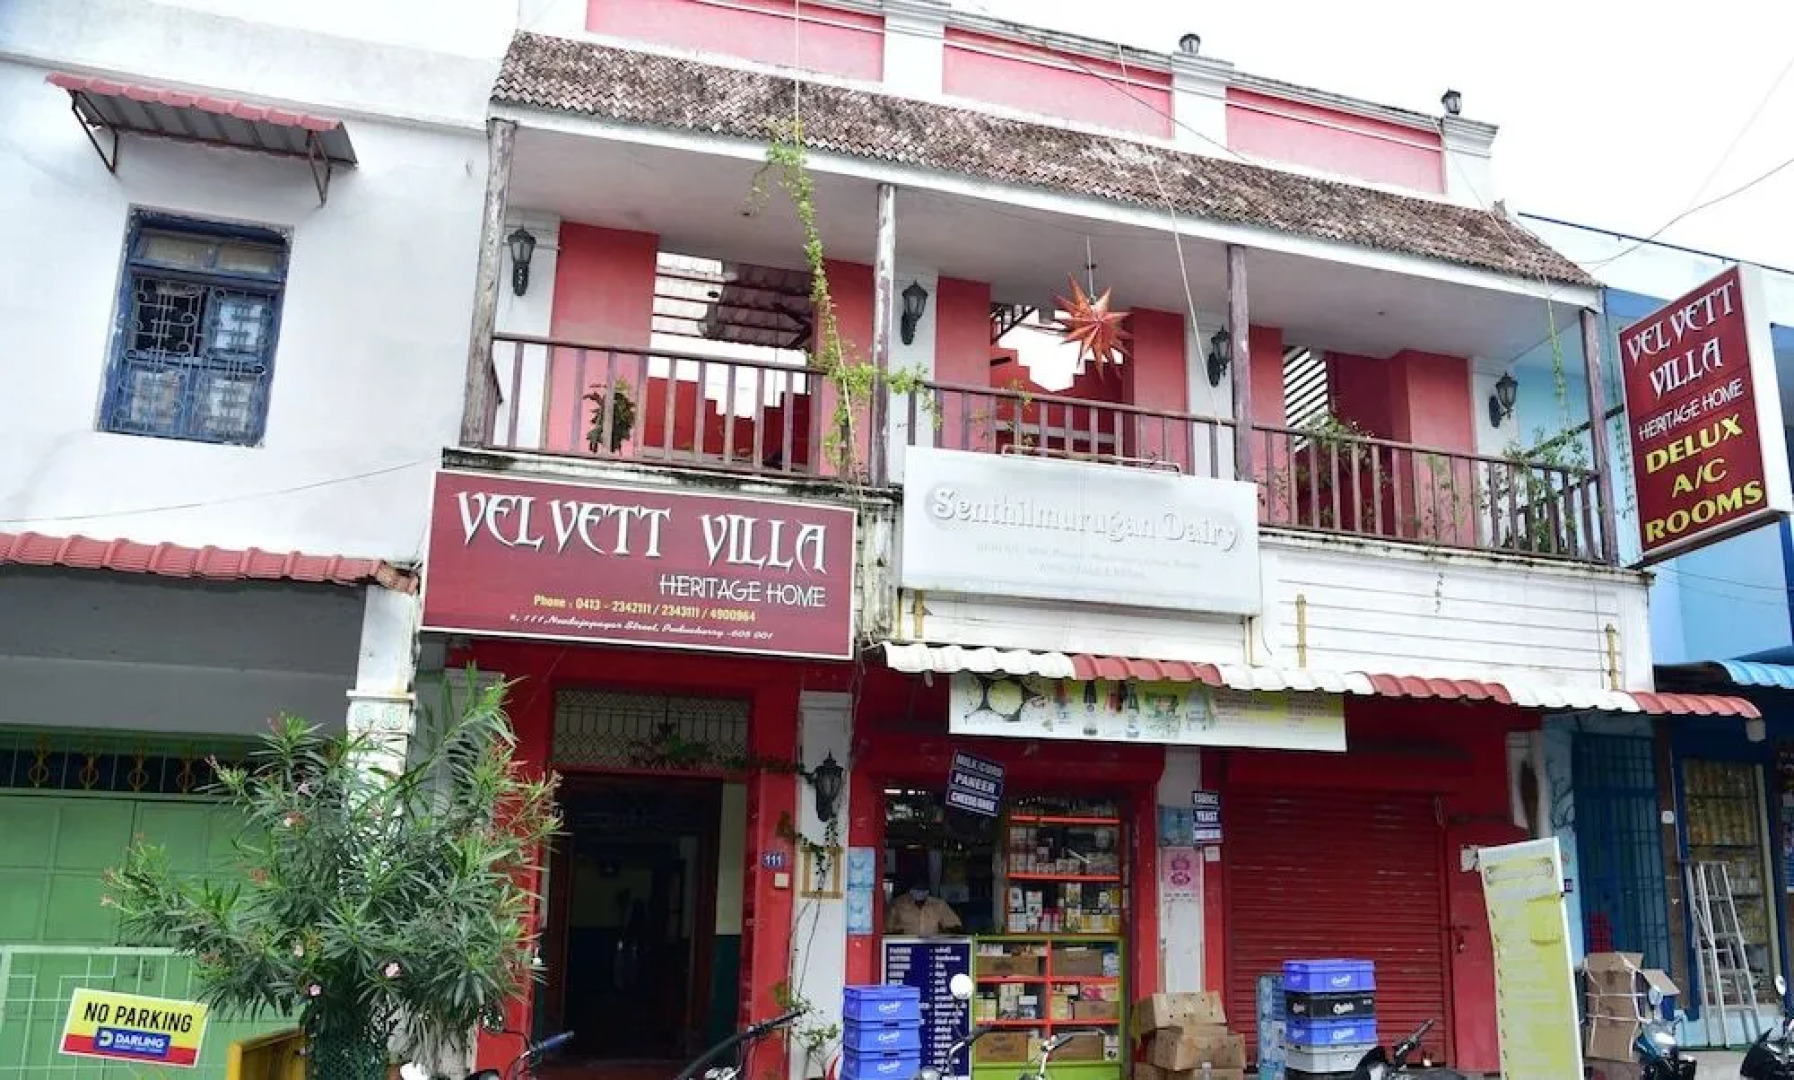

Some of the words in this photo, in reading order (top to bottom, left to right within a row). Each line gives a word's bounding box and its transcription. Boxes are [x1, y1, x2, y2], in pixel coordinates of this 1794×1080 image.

[1649, 337, 1723, 399] VILLA
[1638, 398, 1701, 442] HERITAGE
[1702, 378, 1744, 413] HOME
[1645, 413, 1743, 474] DELUX
[1671, 458, 1728, 498] A/C
[932, 486, 1157, 542] Senthilmurugan
[1161, 506, 1239, 553] Dairy
[1645, 480, 1764, 543] ROOMS
[699, 514, 828, 573] VILLA
[534, 594, 566, 609] Phone
[575, 597, 600, 611] 0413
[659, 573, 762, 602] HERITAGE
[765, 582, 827, 608] HOME
[954, 773, 996, 794] PANEER
[765, 854, 782, 865] 111
[84, 1001, 110, 1023] NO
[114, 1005, 193, 1033] PARKING
[114, 1033, 165, 1047] DARLING
